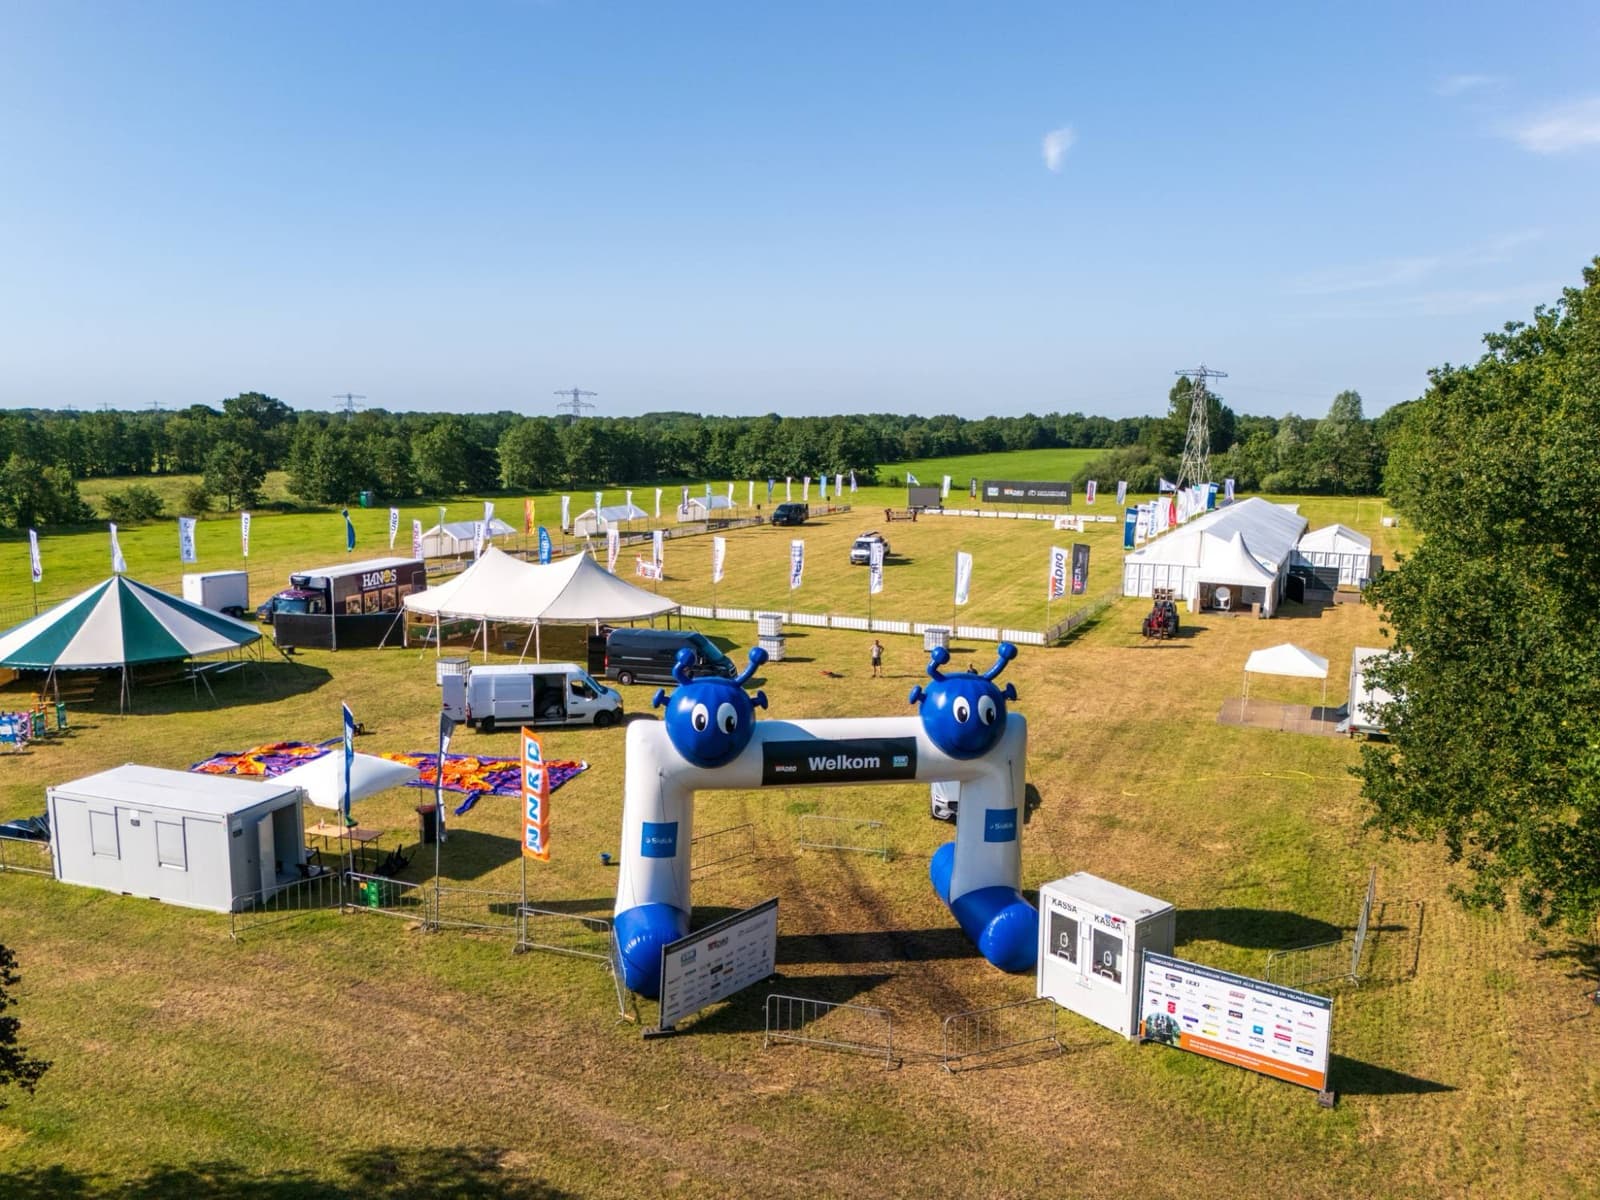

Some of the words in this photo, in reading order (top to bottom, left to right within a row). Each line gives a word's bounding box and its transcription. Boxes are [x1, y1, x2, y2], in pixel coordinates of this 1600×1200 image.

[1054, 553, 1064, 598] WADRO
[808, 755, 881, 771] Welkom
[1051, 897, 1077, 913] KASSA
[1094, 914, 1121, 931] KASSA
